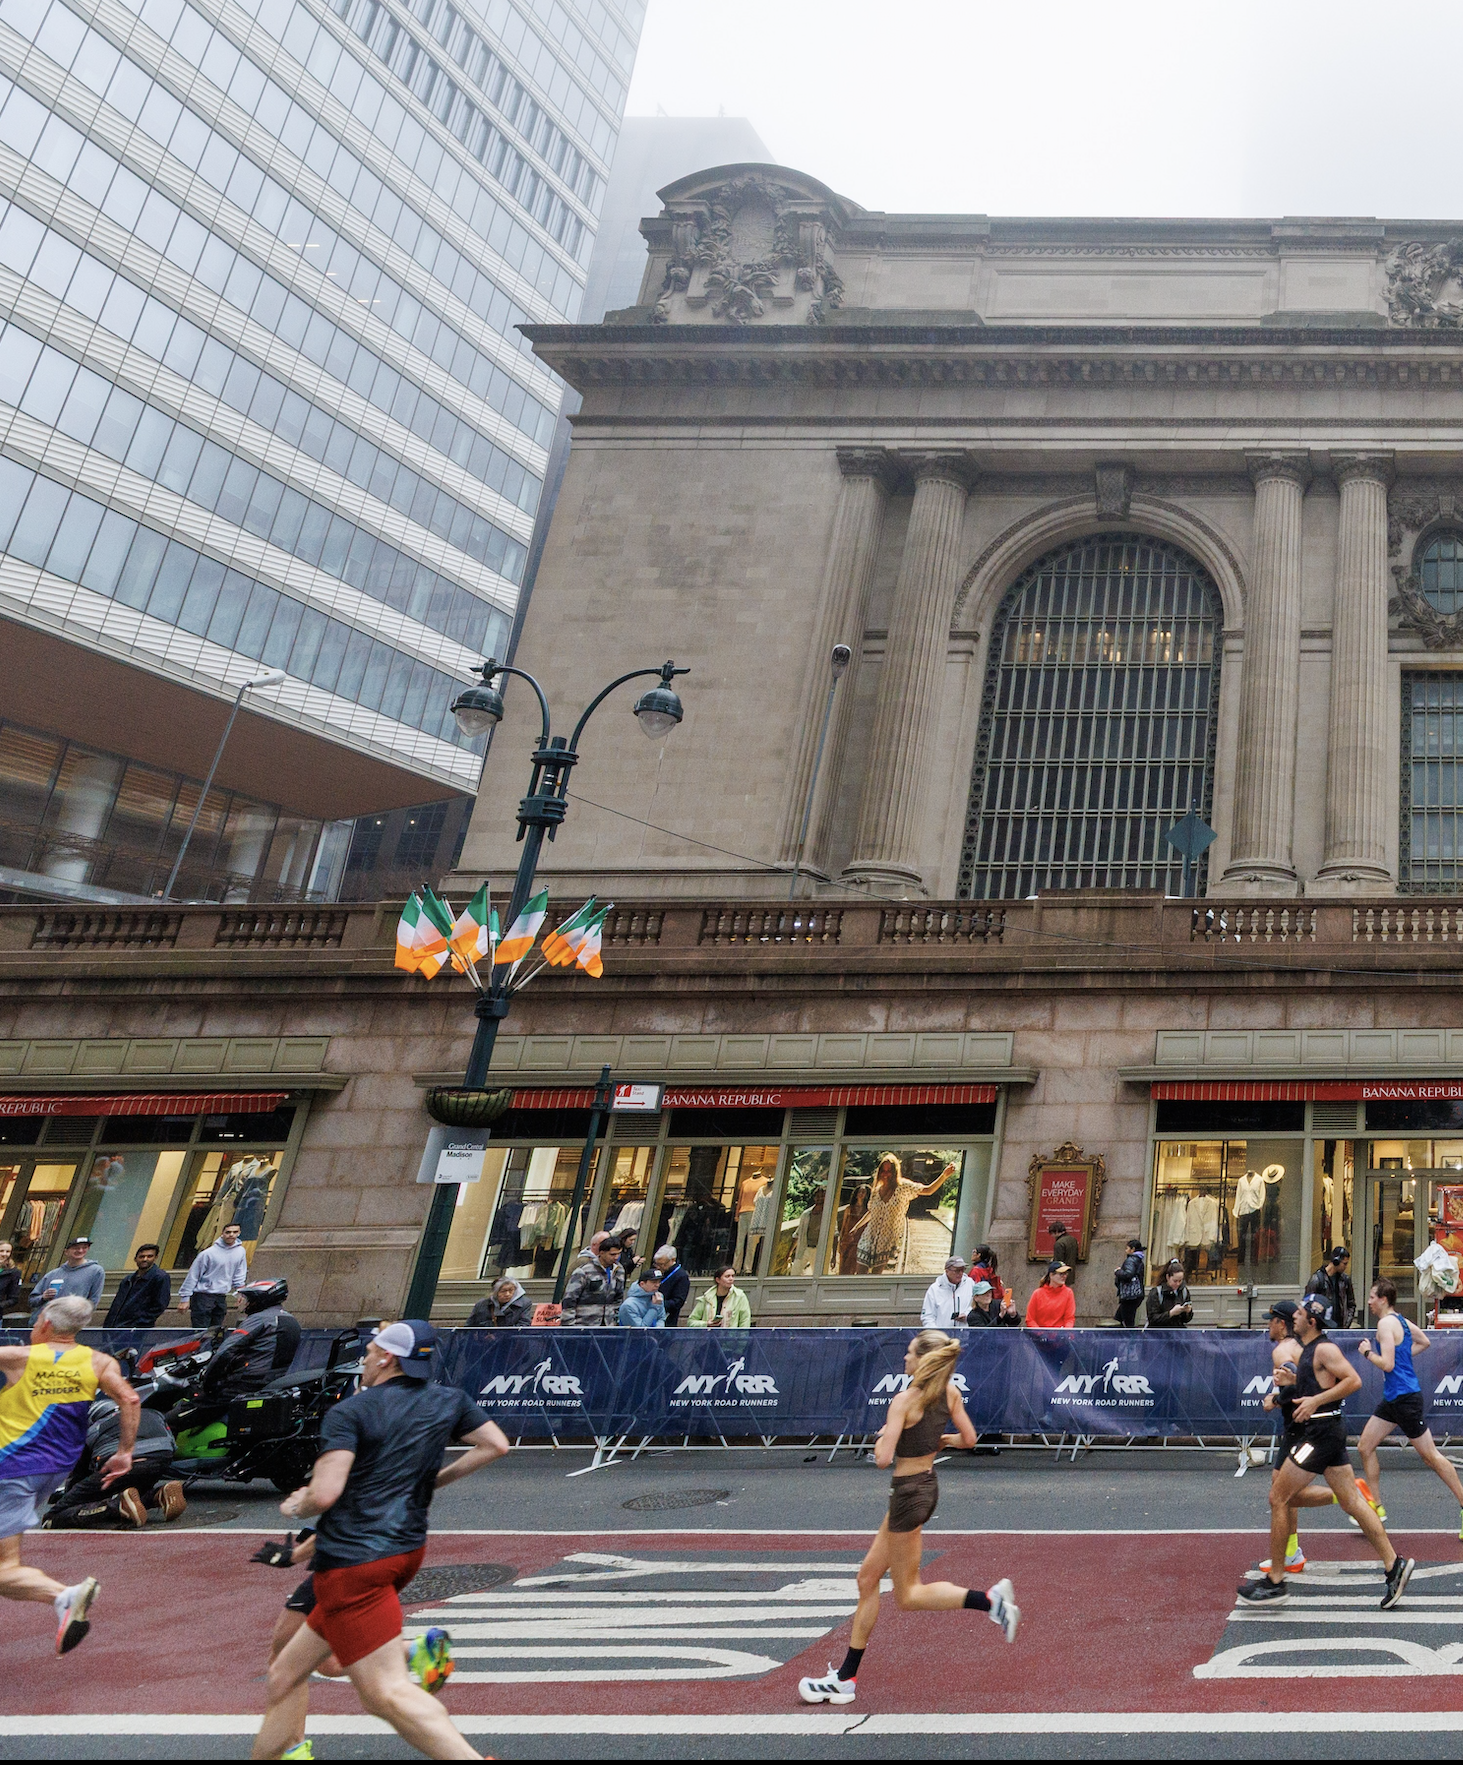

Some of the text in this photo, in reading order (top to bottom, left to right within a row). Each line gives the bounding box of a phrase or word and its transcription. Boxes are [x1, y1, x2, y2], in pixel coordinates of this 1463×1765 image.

[1362, 1087, 1416, 1098] BANANA
[662, 1094, 781, 1106] BANANA REPUBLIC
[0, 1102, 62, 1114] REPUBLIC
[467, 1142, 484, 1150] Central
[1052, 1181, 1075, 1189] MAKE
[1042, 1189, 1084, 1197] EVERYDAY
[35, 1371, 81, 1379] MACCA
[480, 1374, 584, 1394] NYRR
[672, 1374, 780, 1394] NYRR
[871, 1373, 971, 1392] NYR
[1054, 1374, 1155, 1394] NYRR
[32, 1386, 80, 1397] STRIDERS
[497, 1399, 520, 1407] YORK
[522, 1399, 544, 1407] ROAD
[546, 1399, 582, 1407] RUNNERS
[670, 1399, 689, 1407] NEW
[691, 1399, 712, 1407] YORK
[714, 1399, 738, 1407] ROAD
[1072, 1398, 1093, 1406] YORK
[1095, 1398, 1117, 1406] ROAD
[1119, 1399, 1154, 1407] RUNNERS
